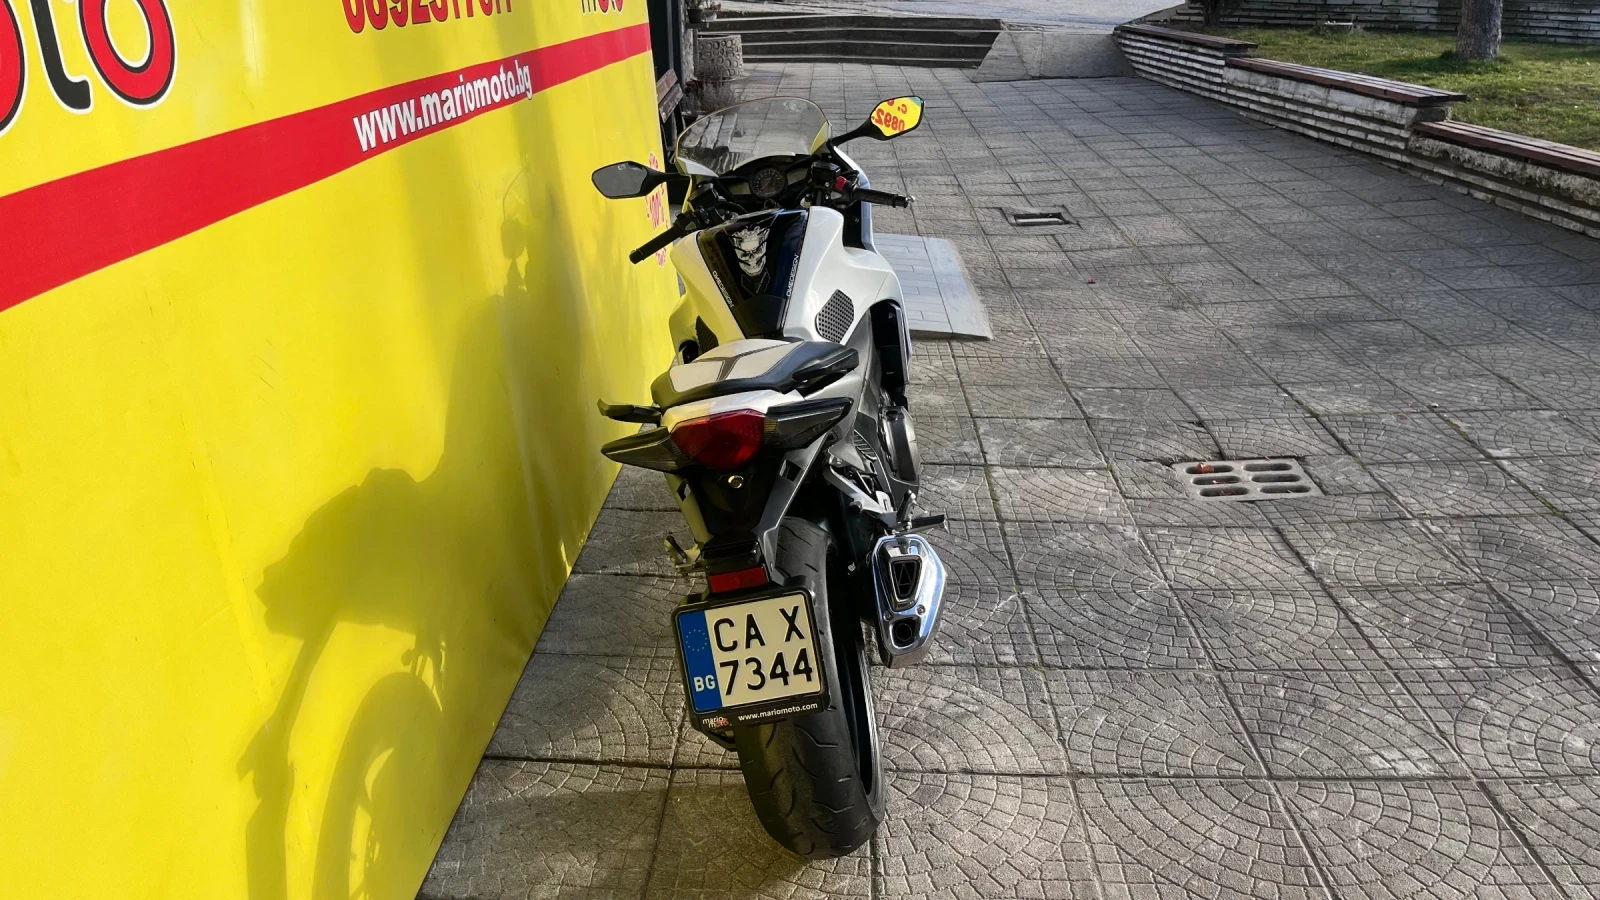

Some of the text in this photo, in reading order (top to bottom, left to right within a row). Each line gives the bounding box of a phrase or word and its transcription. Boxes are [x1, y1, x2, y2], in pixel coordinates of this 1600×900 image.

[353, 59, 533, 152] www.mariomoto.bg
[713, 605, 806, 653] CA X
[693, 674, 716, 693] BG
[719, 647, 813, 696] 7344
[738, 702, 818, 722] www.mariomoto.com
